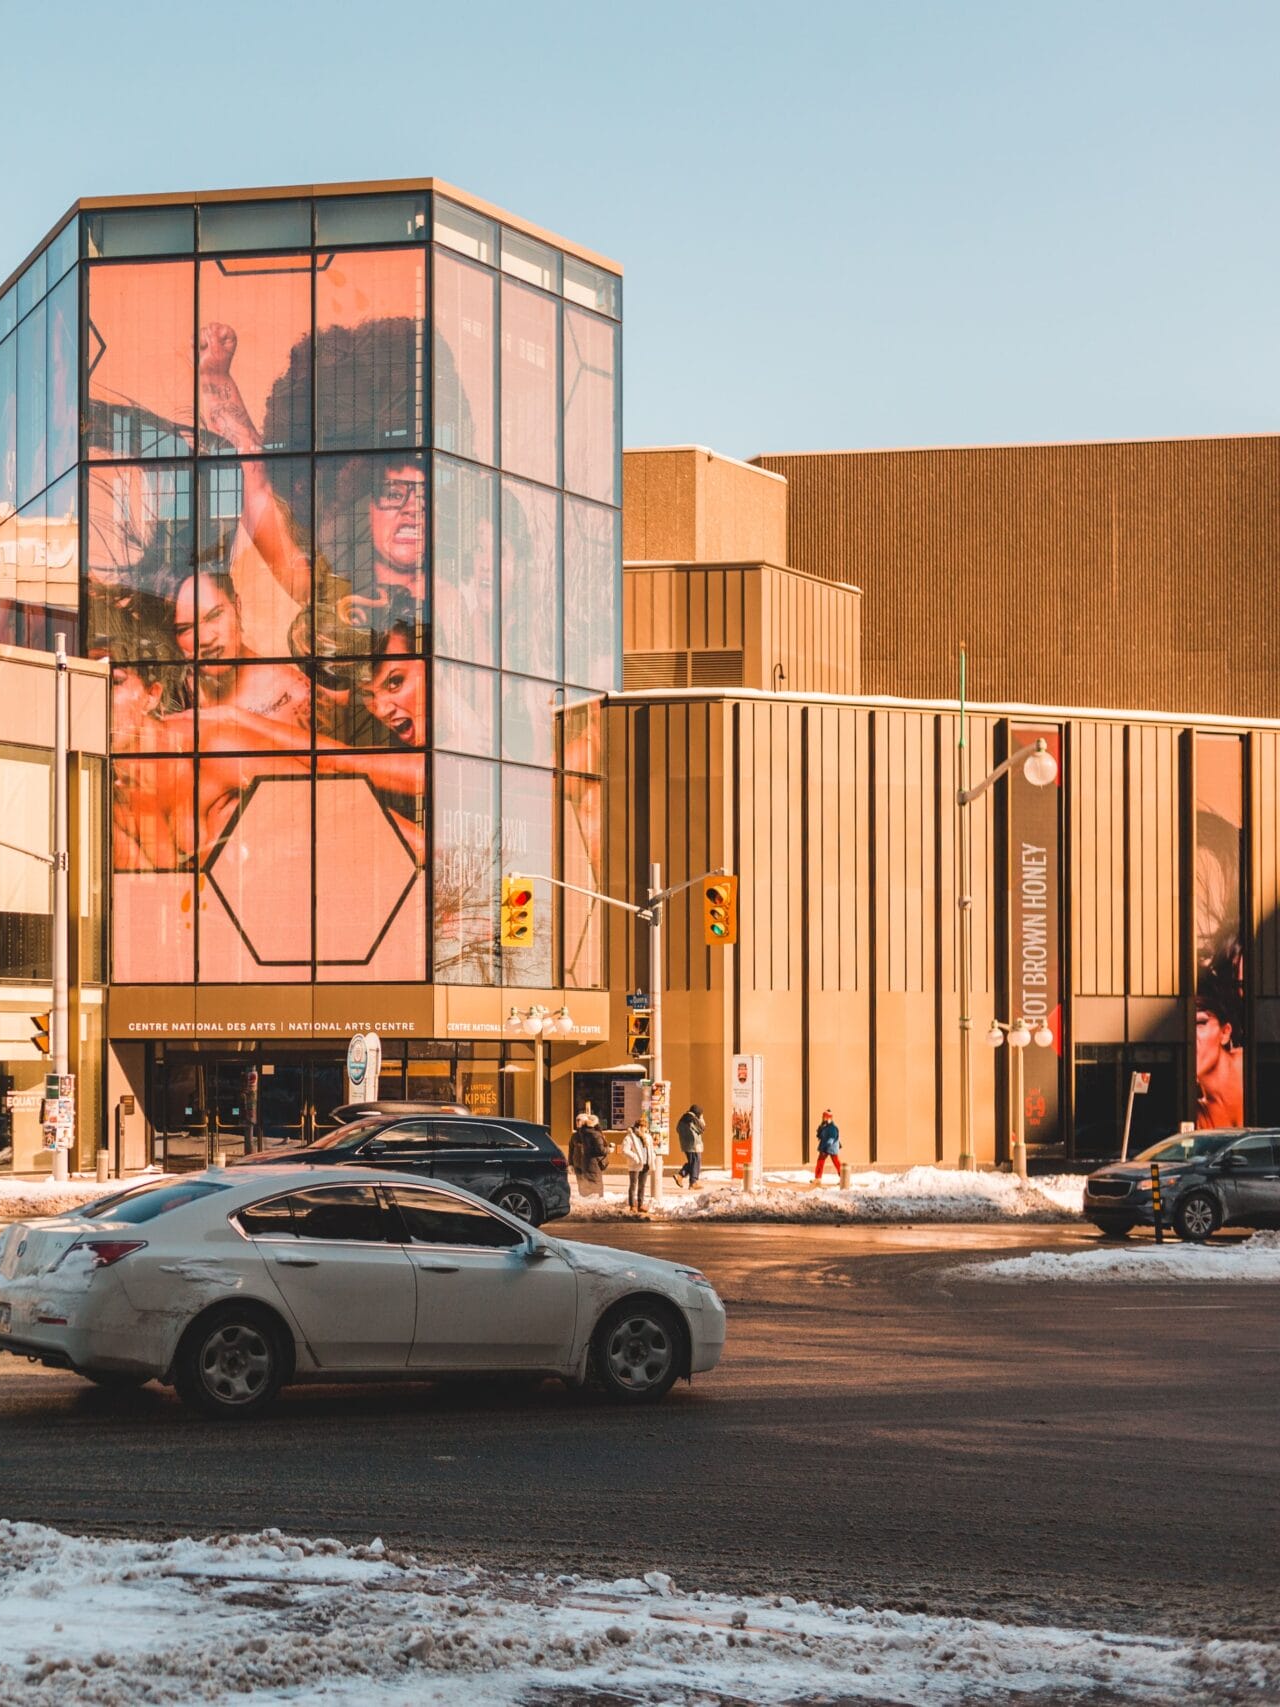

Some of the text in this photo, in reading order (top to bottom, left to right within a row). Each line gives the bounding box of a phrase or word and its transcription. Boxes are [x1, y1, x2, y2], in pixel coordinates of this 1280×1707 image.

[443, 808, 471, 846] HOT
[443, 849, 486, 889] HONEY
[1022, 843, 1048, 909] HONEY
[1022, 914, 1048, 985] BROWN
[128, 1022, 416, 1031] CENTRE NATIONAL DES ARTS NATIONAL ARTS CENTRE
[447, 1023, 471, 1031] CENTRE
[472, 1023, 502, 1032] NATIONAL
[580, 1025, 601, 1034] CENTRE
[6, 1096, 42, 1107] EQUATO
[465, 1093, 497, 1105] KIPNES
